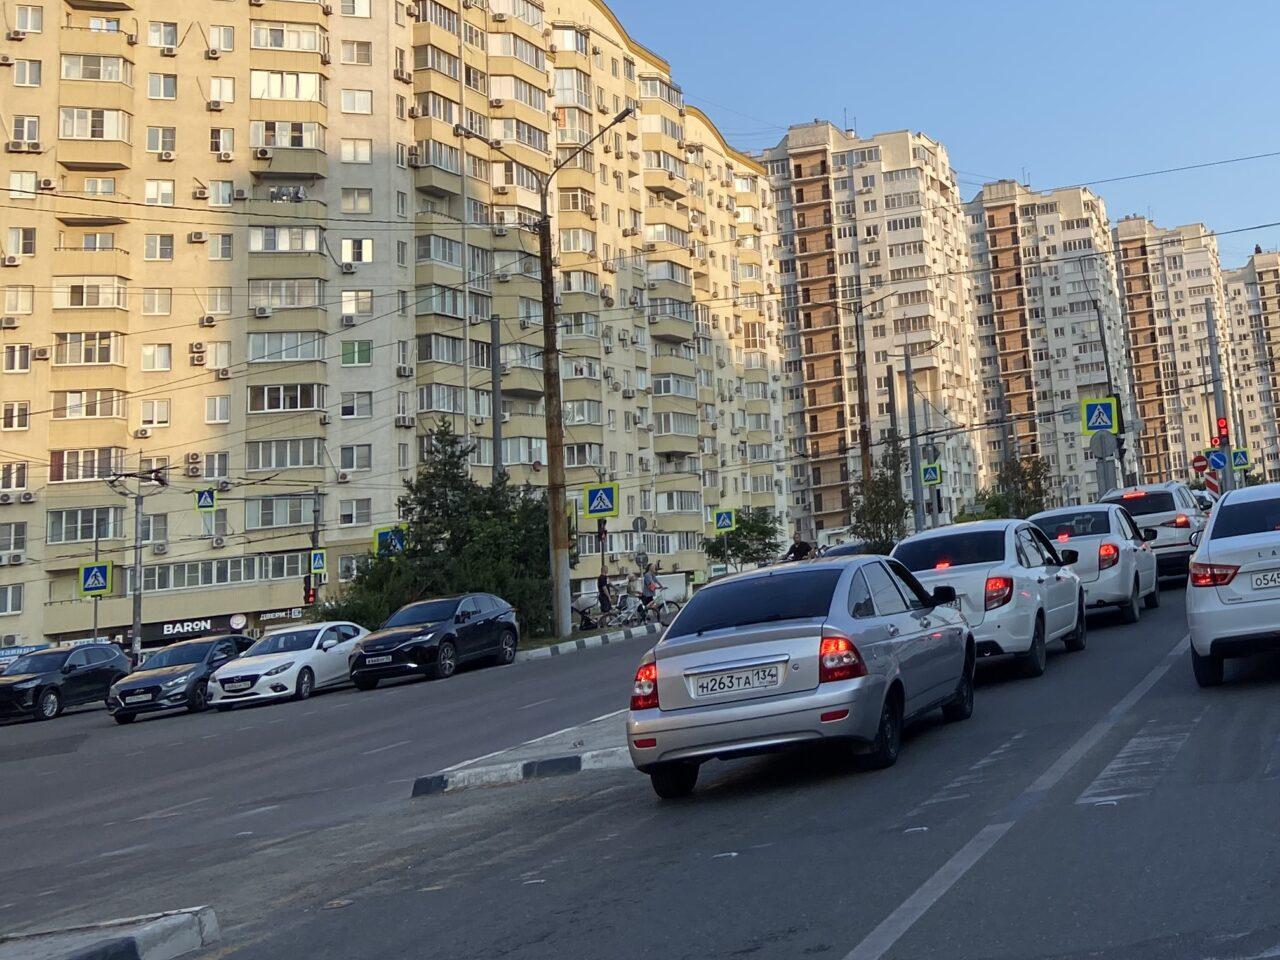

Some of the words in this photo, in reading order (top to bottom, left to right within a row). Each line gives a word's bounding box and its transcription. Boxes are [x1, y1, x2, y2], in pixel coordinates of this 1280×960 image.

[163, 619, 211, 635] BARON
[701, 675, 751, 693] Н263ТА
[754, 669, 774, 681] 134
